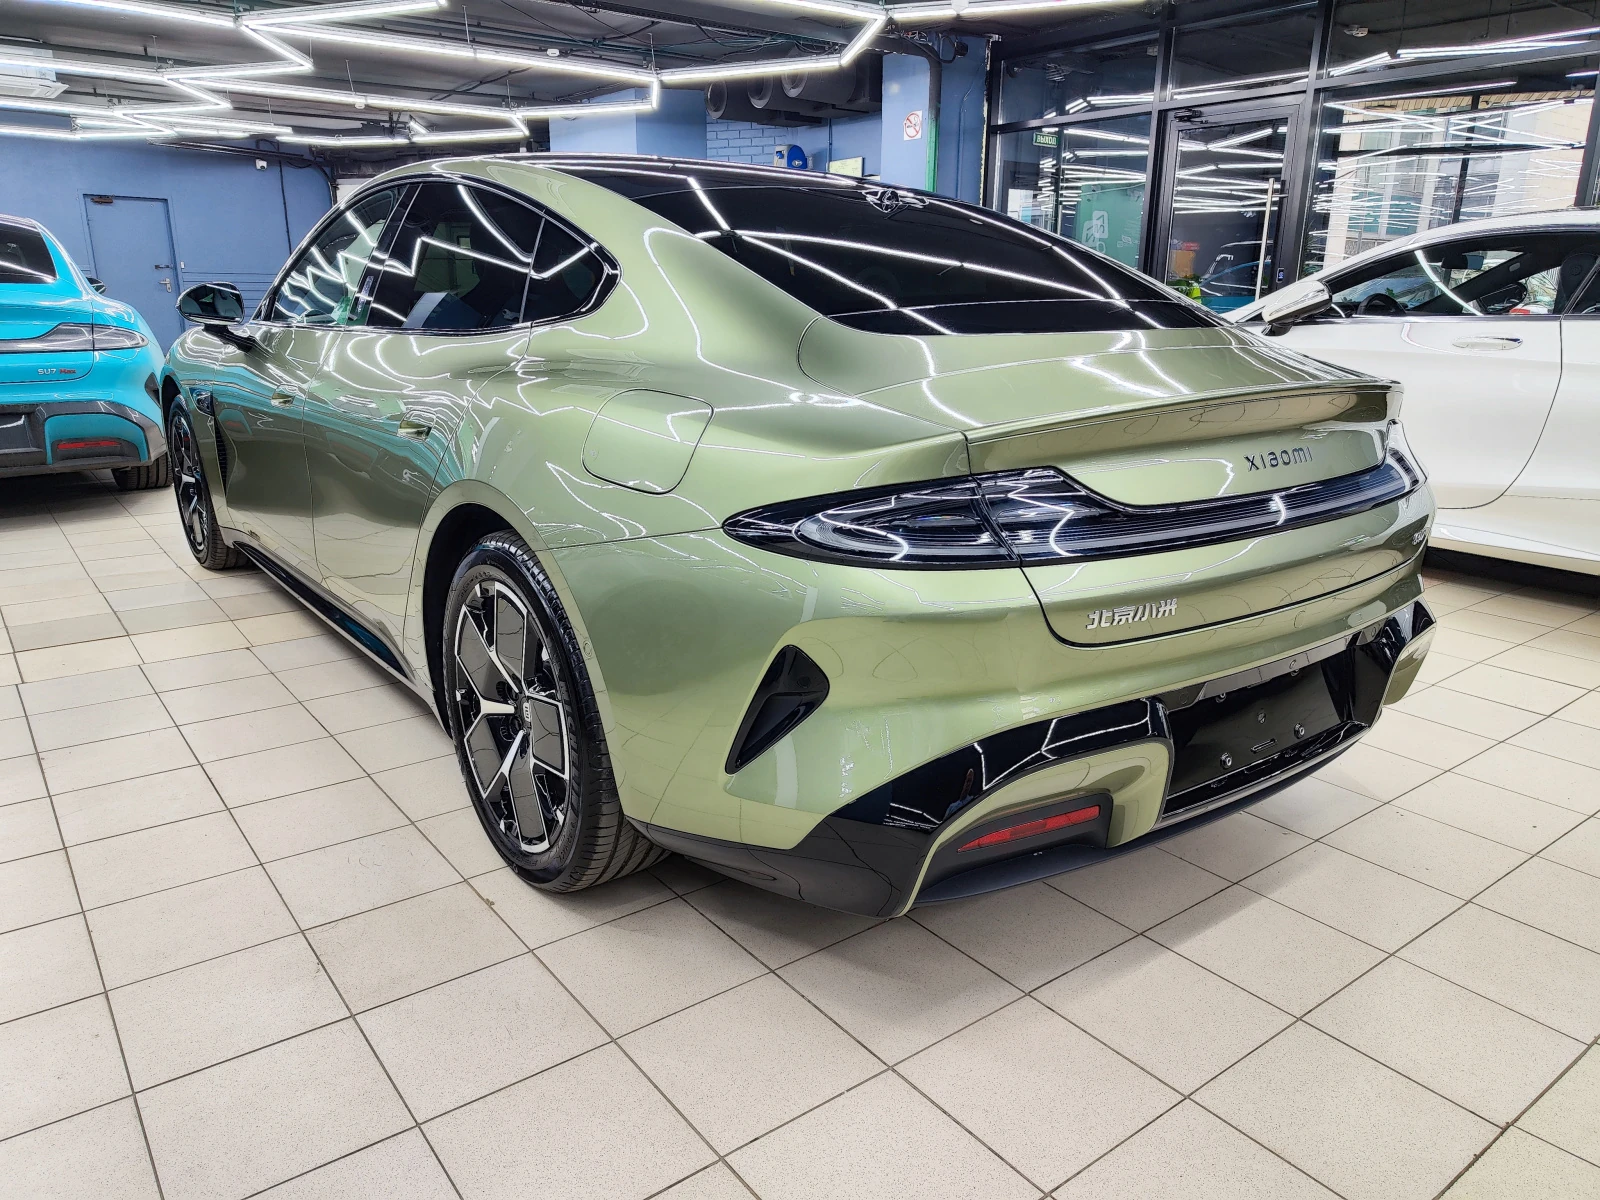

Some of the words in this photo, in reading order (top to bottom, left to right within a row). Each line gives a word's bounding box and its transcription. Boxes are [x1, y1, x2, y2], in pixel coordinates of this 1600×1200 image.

[1036, 134, 1057, 145] ВЫХОД
[1086, 598, 1178, 630] 北京小米
[559, 680, 580, 817] MICHELIN
